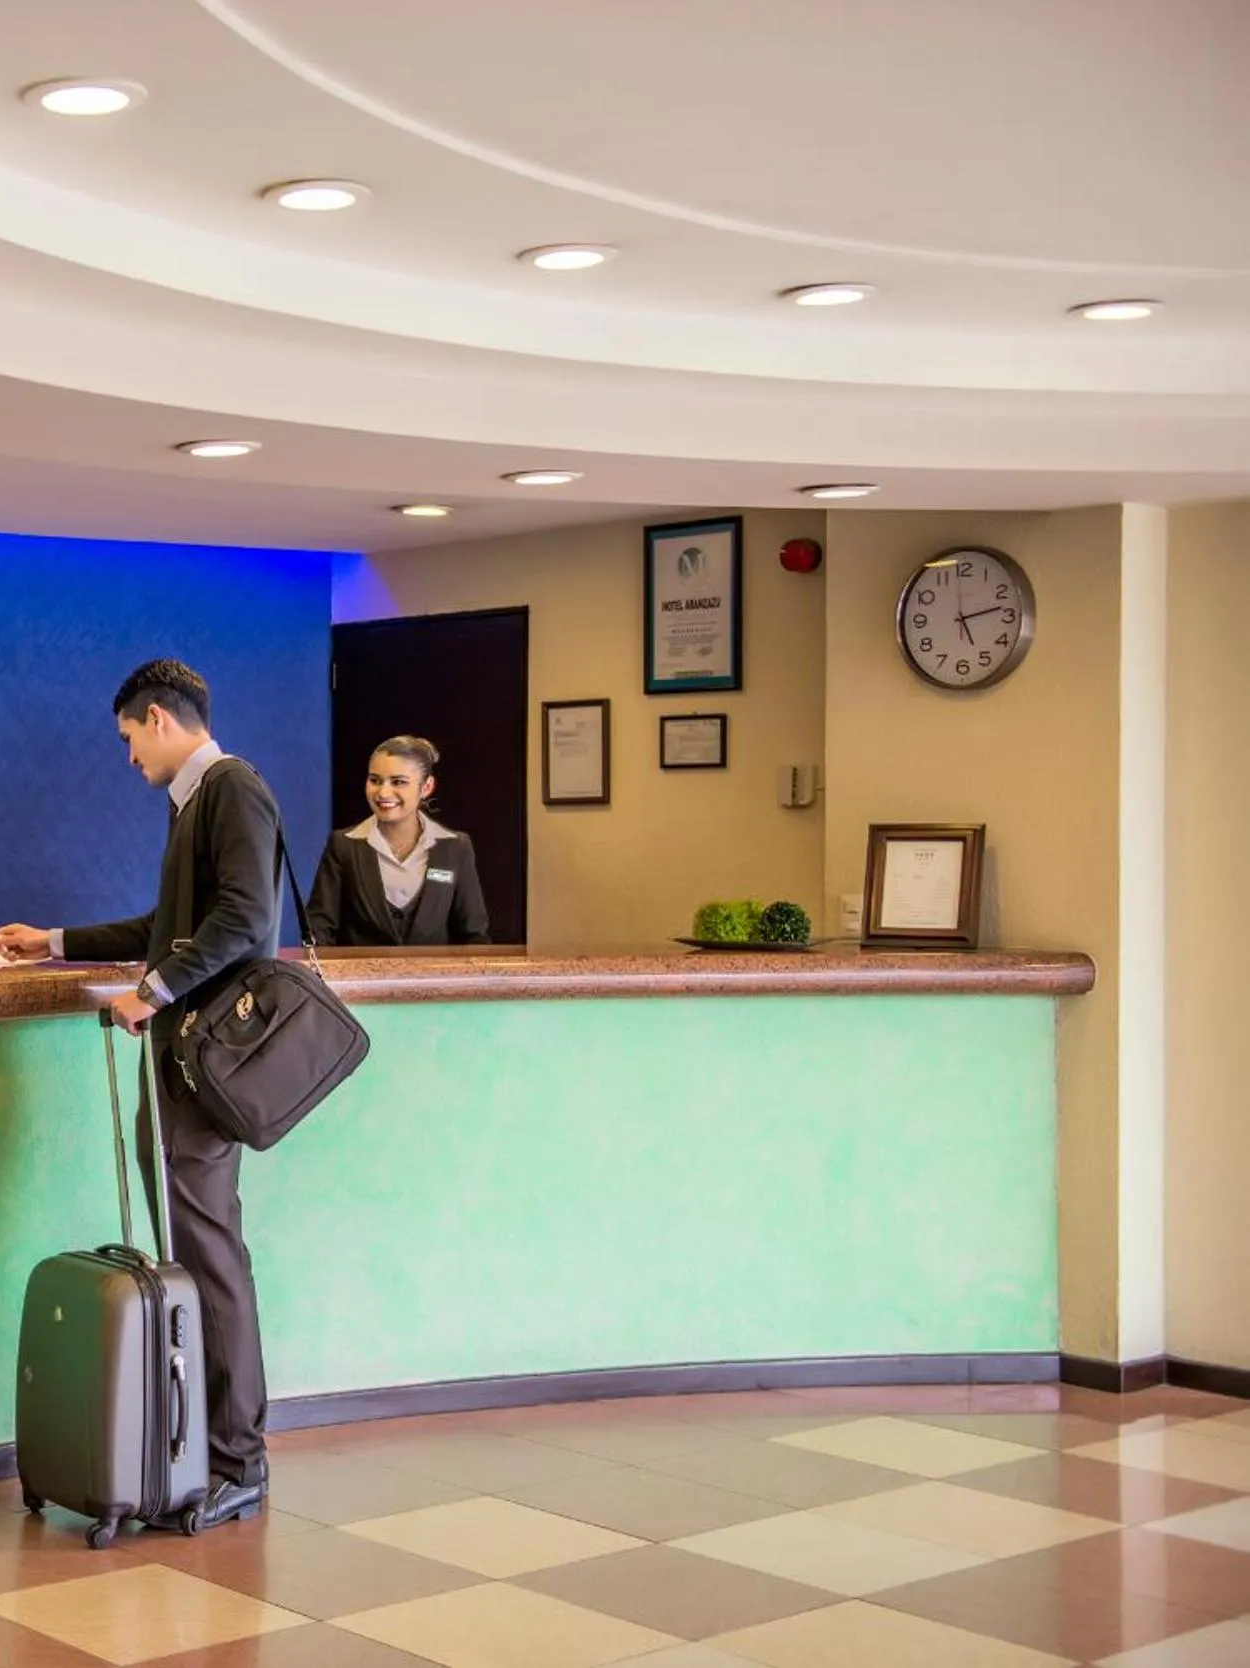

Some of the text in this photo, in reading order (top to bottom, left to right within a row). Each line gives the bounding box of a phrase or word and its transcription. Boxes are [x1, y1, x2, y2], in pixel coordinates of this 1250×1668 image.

[956, 562, 973, 577] 12
[936, 570, 949, 586] 11
[917, 589, 935, 605] 10
[995, 584, 1008, 599] 2
[661, 600, 683, 612] HOTEL
[912, 613, 927, 628] 9
[1001, 608, 1016, 624] 3
[919, 637, 933, 652] 8
[994, 632, 1009, 647] 4
[936, 654, 947, 670] 7
[978, 651, 991, 666] 5
[955, 659, 970, 675] 6
